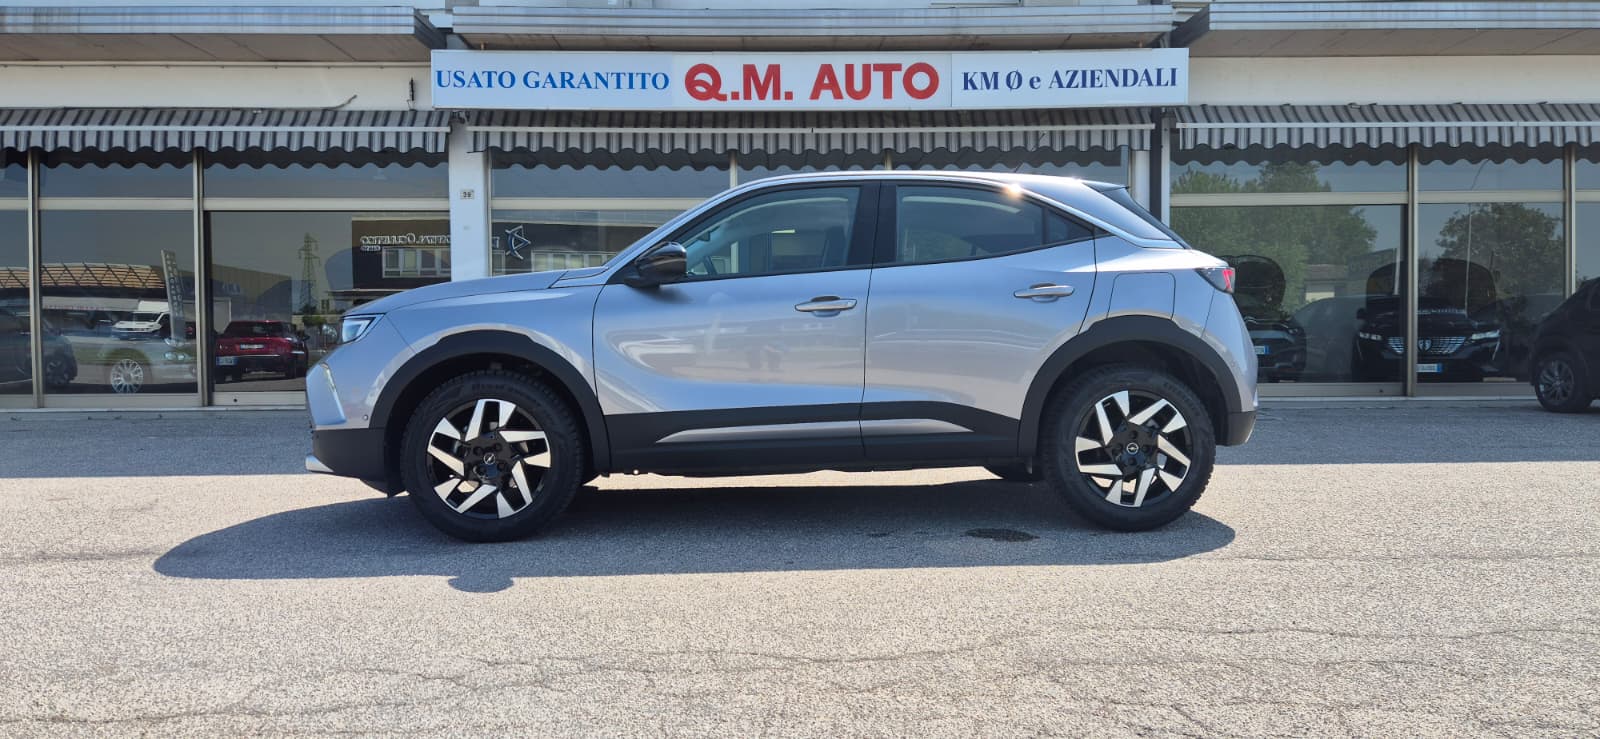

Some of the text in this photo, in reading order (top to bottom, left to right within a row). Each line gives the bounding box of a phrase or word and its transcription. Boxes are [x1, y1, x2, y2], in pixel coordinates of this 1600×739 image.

[435, 69, 670, 90] USATO GARANTITO
[684, 62, 940, 102] Q.M. AUTO
[963, 71, 999, 91] KM
[1029, 76, 1042, 90] e
[1048, 68, 1178, 90] AZIENDALI
